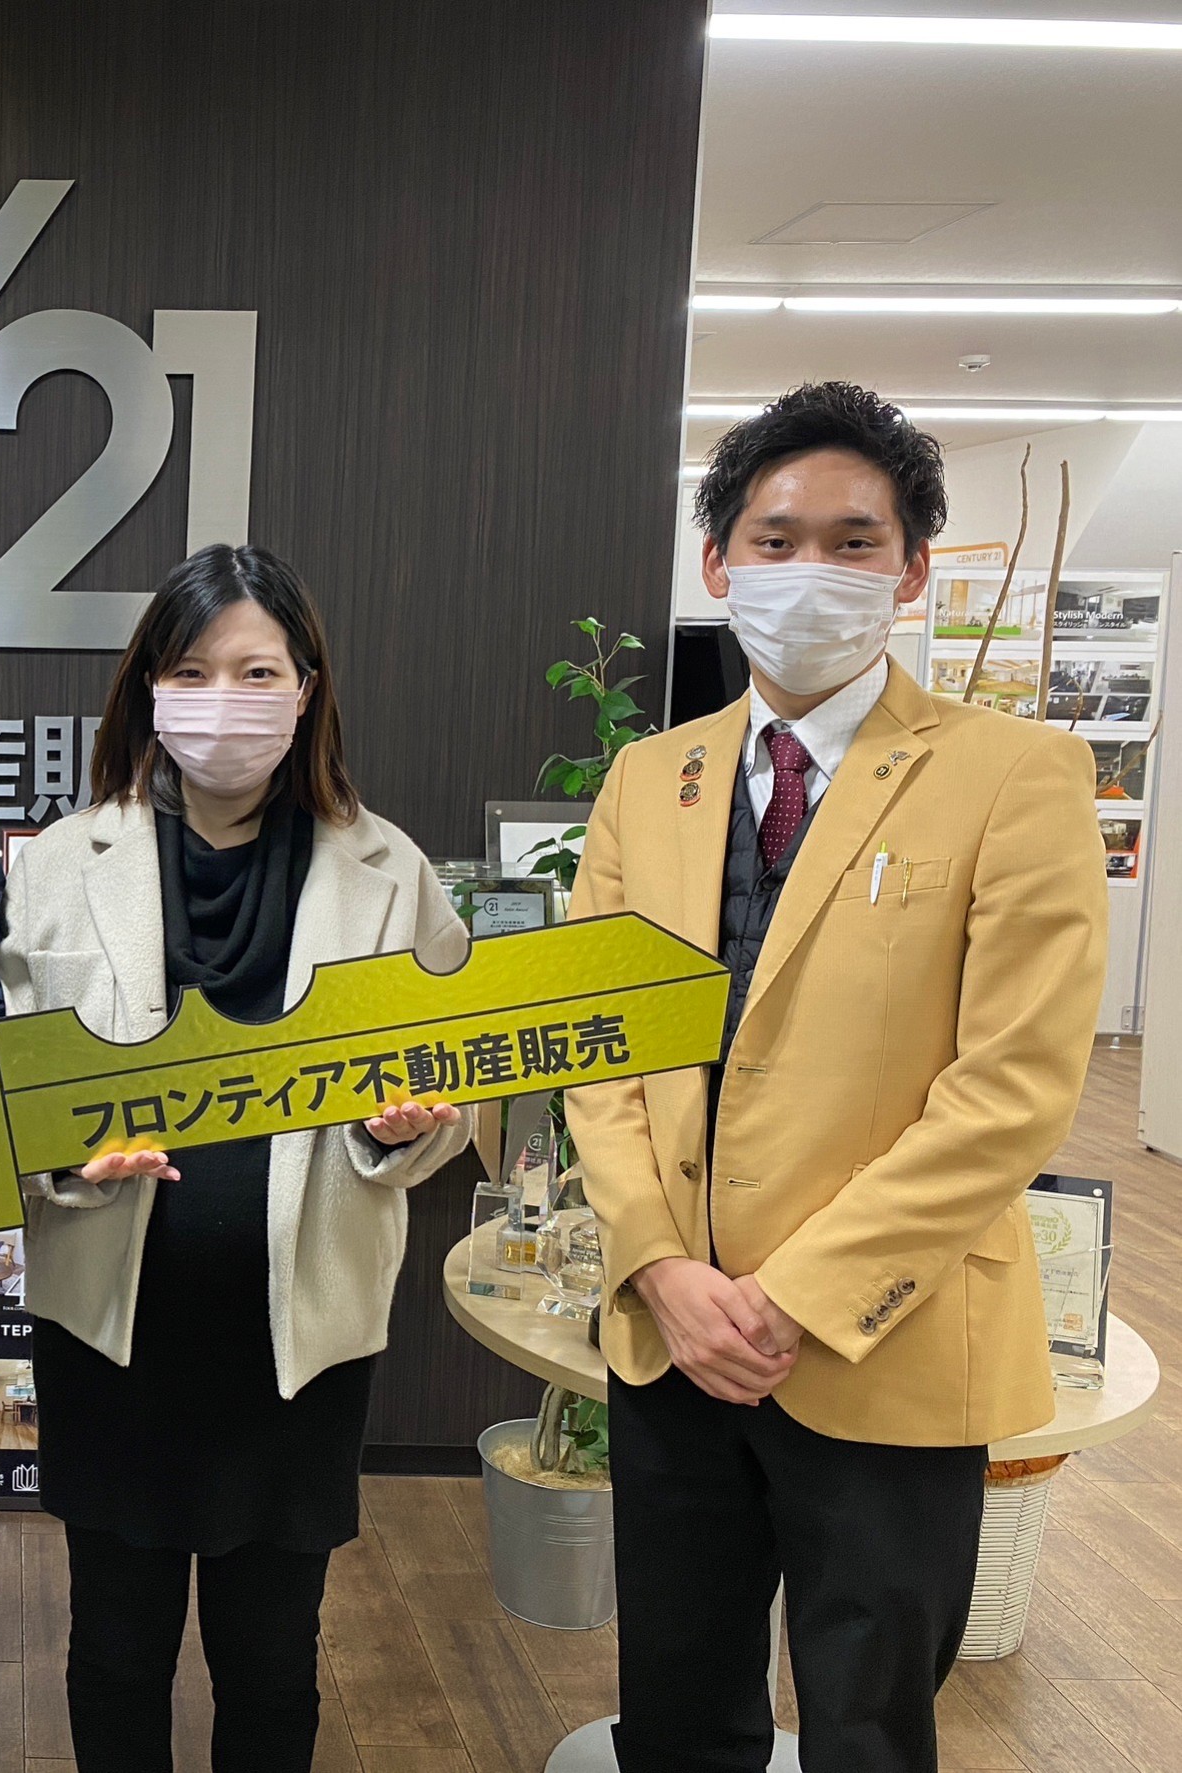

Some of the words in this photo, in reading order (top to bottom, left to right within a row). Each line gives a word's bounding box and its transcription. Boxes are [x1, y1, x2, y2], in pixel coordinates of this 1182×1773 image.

[956, 554, 993, 564] CENTURY
[994, 551, 1002, 561] 21
[1053, 610, 1084, 620] Stylish
[1085, 610, 1124, 620] Modern
[71, 1013, 630, 1149] フロンティア不動産販売
